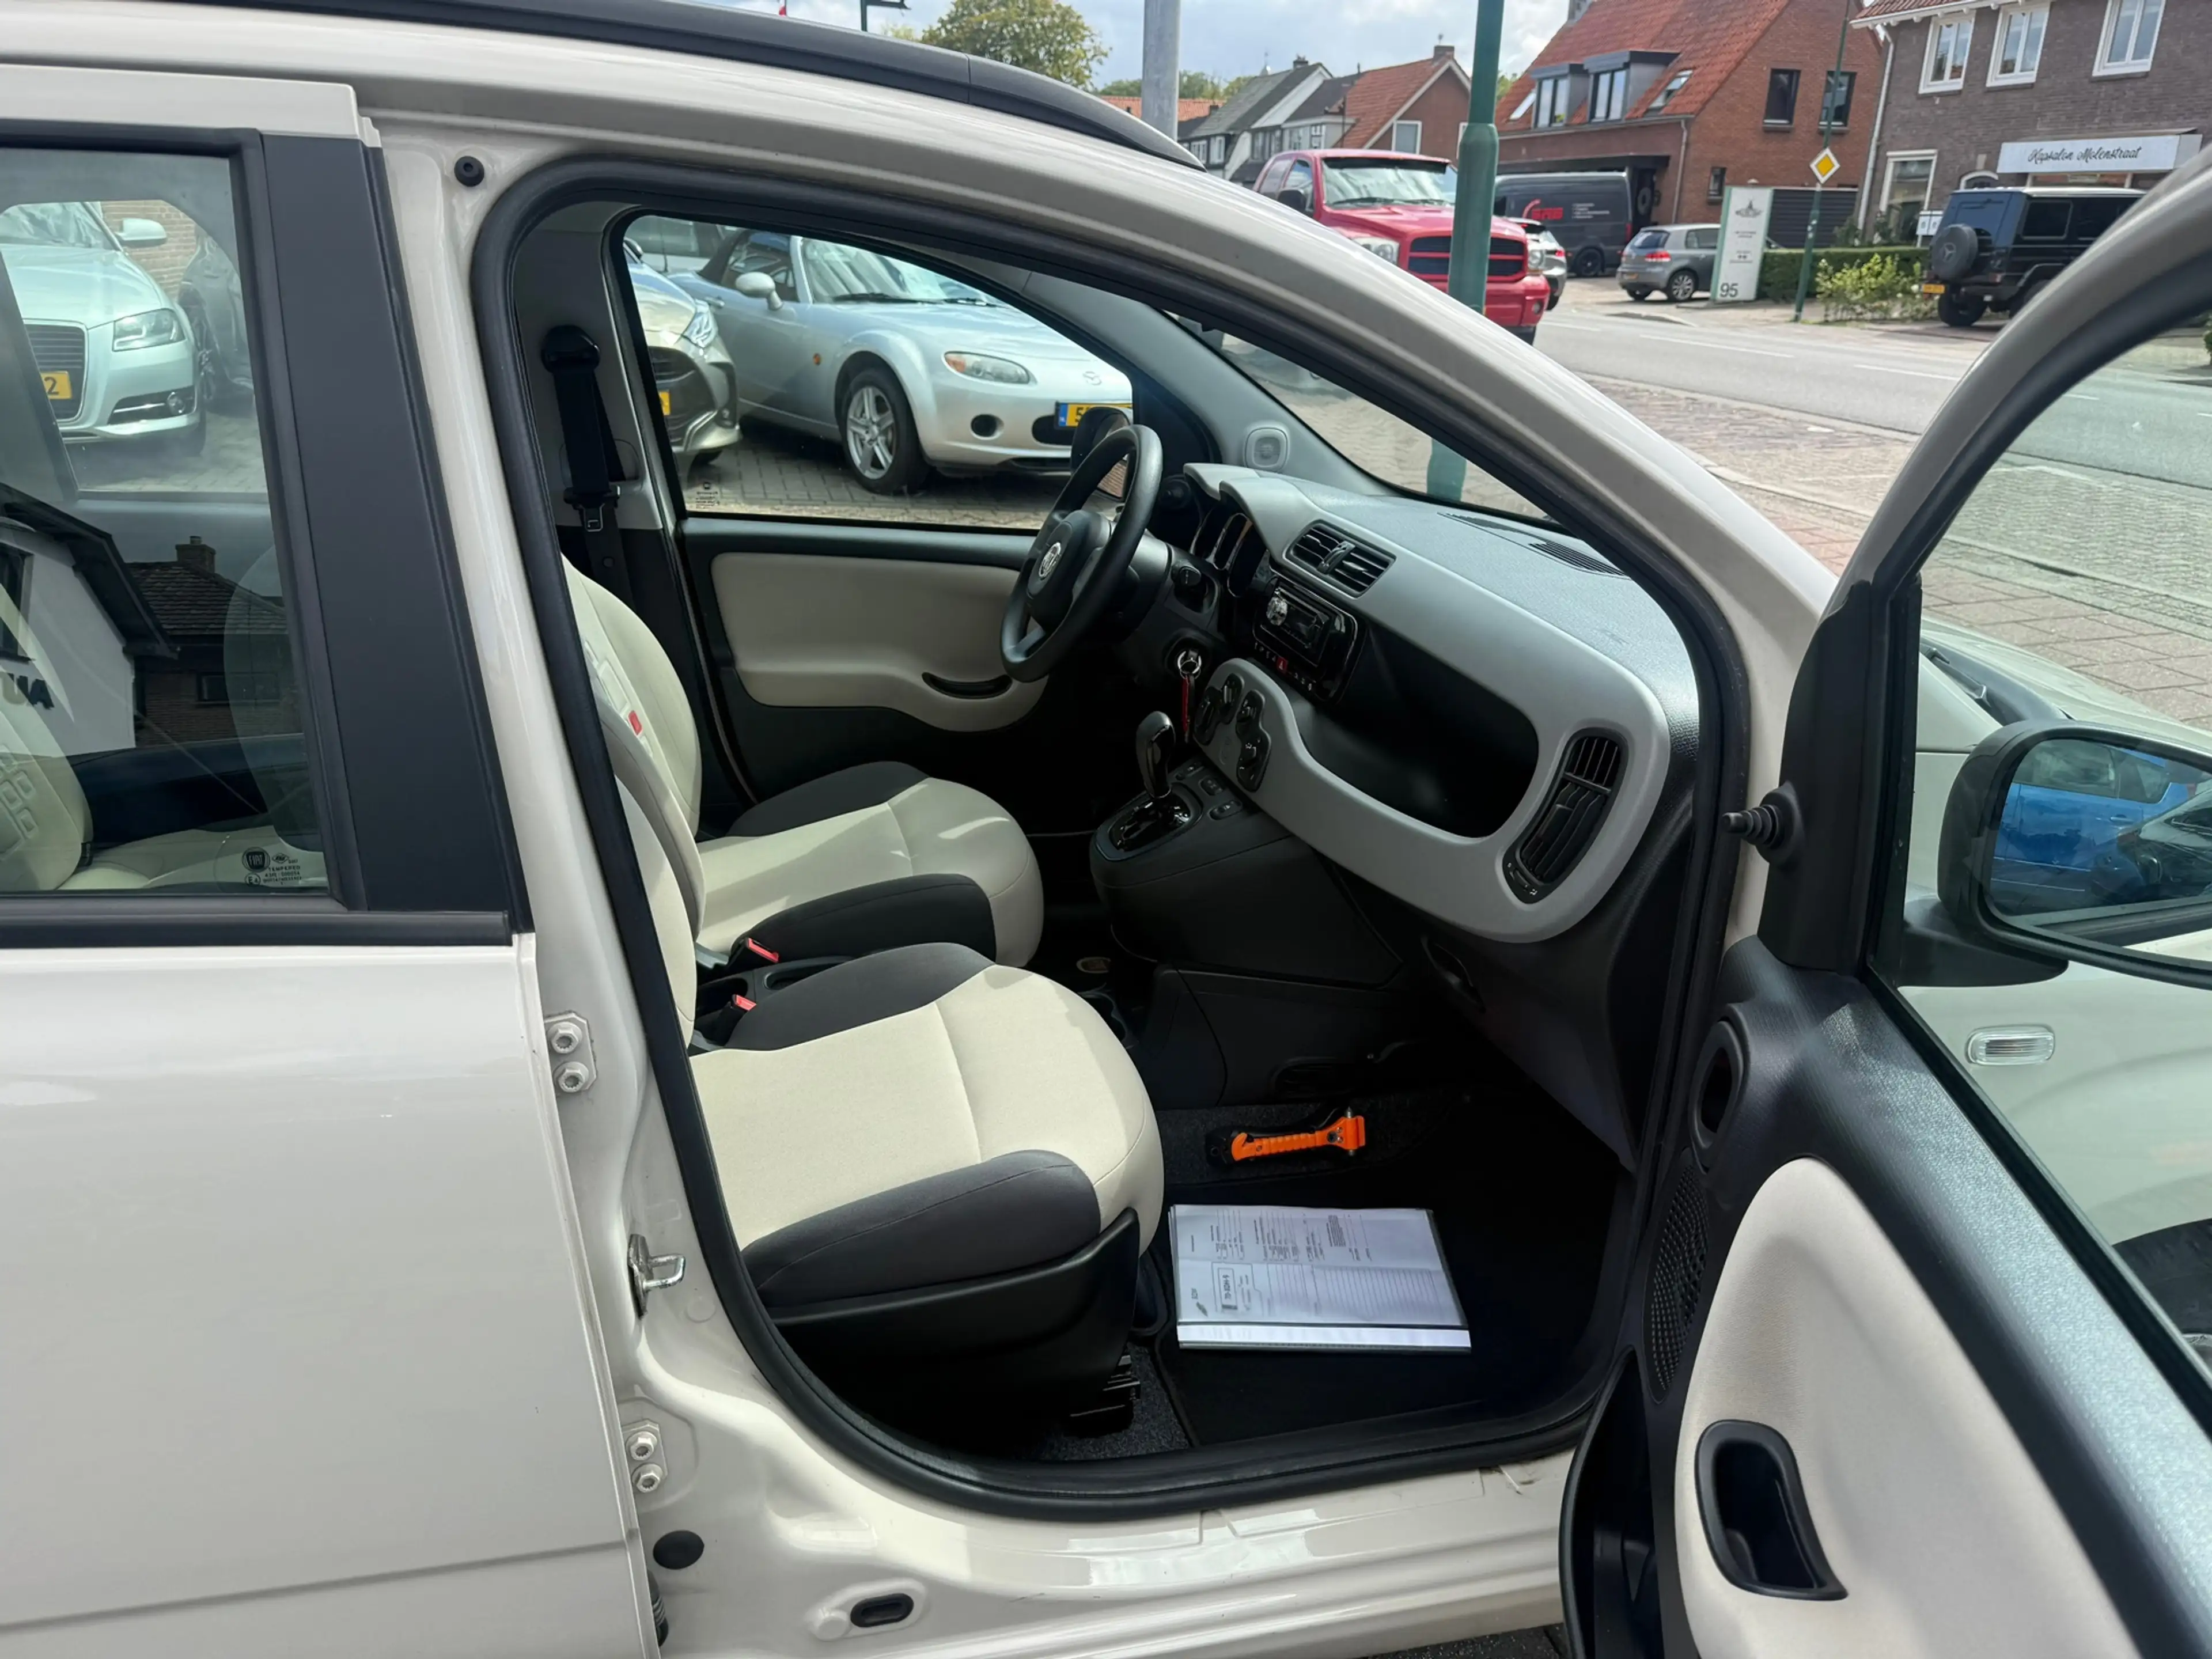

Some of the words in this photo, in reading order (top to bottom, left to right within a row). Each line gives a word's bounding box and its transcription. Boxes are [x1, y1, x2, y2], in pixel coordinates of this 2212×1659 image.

[2028, 147, 2074, 164] Kapsalon
[2077, 146, 2142, 163] Molenstraat
[1719, 282, 1738, 298] 95
